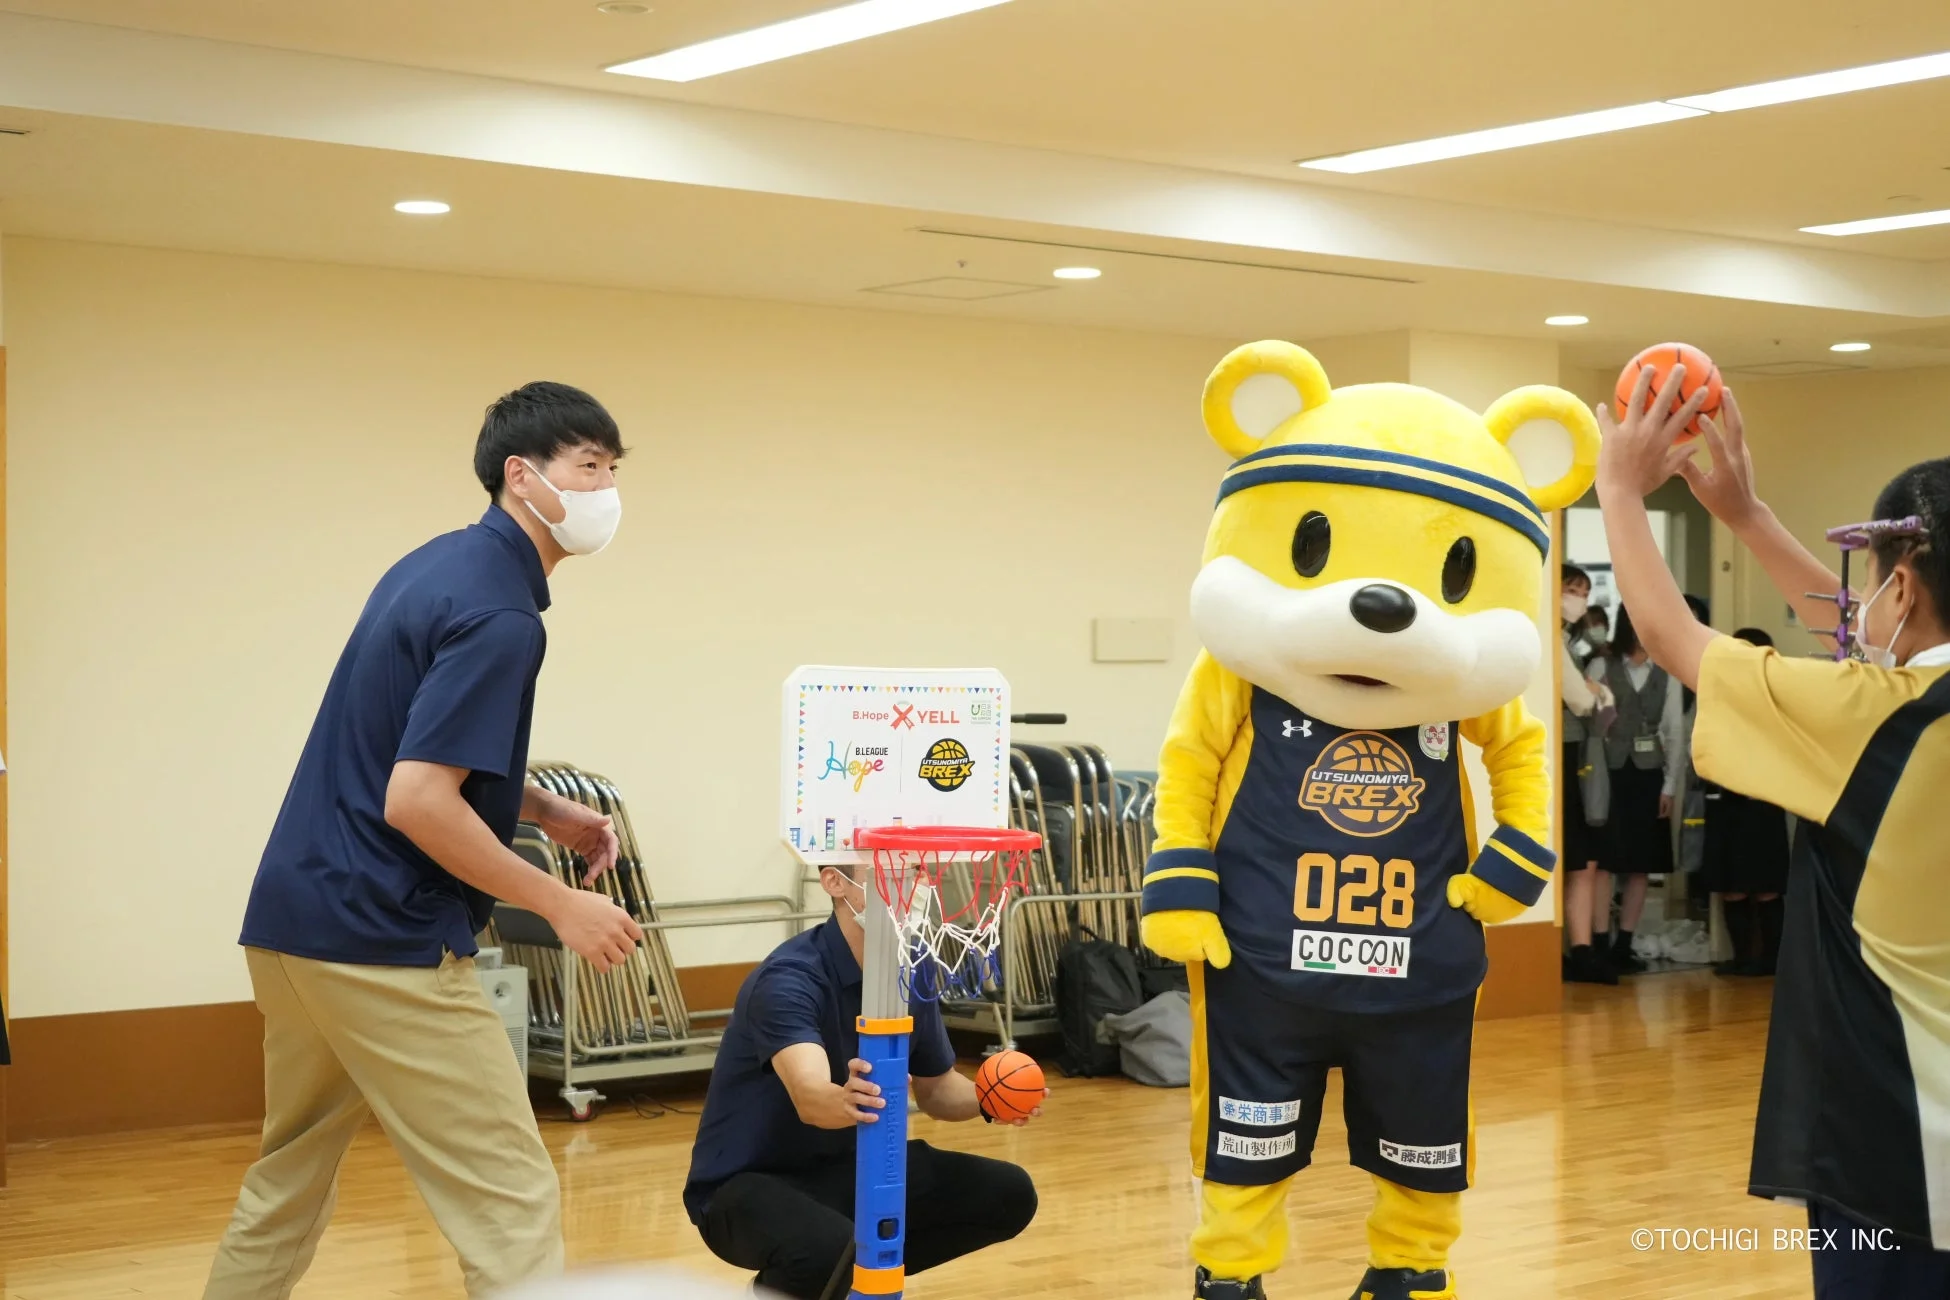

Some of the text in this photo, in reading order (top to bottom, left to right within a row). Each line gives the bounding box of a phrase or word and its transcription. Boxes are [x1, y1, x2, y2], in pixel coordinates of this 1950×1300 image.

[852, 710, 889, 721] B.Hope
[917, 710, 960, 724] YELL
[855, 747, 889, 756] B.LEAGUE
[817, 740, 885, 793] Hope
[919, 761, 975, 778] BREX
[922, 757, 968, 766] UTSUNOMIYA
[1311, 770, 1409, 784] UTSUNOMIYA
[1305, 783, 1420, 808] BREX
[1293, 852, 1415, 929] 028
[1298, 934, 1405, 967] COCOON
[1222, 1135, 1295, 1157] 荒山製作所
